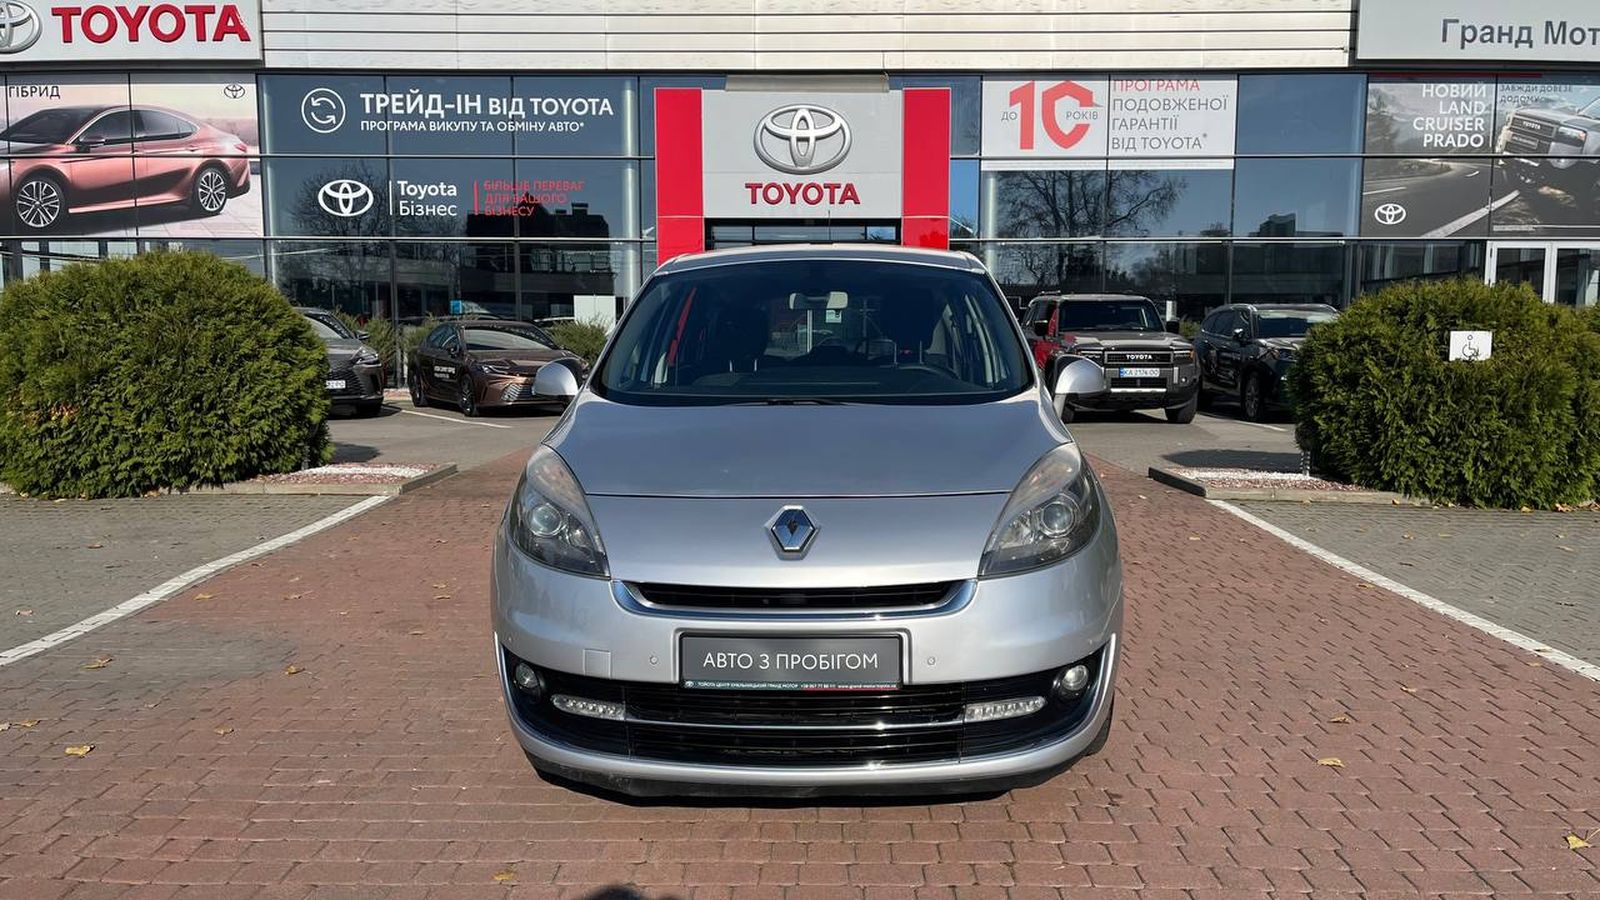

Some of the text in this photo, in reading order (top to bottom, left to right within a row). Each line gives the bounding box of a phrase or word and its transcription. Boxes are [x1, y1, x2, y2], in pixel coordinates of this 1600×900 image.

[51, 4, 251, 43] TOYOTA
[1441, 19, 1533, 50] Гранд
[8, 85, 61, 99] ГІБРИД
[1112, 78, 1200, 92] ПРОГРАМА
[1422, 80, 1487, 98] НОВИЙ
[360, 88, 614, 118] ТРЕЙД-ІН ВІД TOYOTA
[1112, 95, 1229, 112] ПОДОВЖЕНОЇ
[1439, 100, 1486, 115] LAND
[1001, 111, 1018, 121] ДО
[1065, 111, 1099, 120] РОКІВ
[1112, 115, 1178, 131] ГАРАНТІЇ
[1412, 117, 1485, 131] CRUISER
[360, 121, 427, 132] ПРОГРАМА
[429, 121, 478, 132] ВИКУПУ
[480, 121, 494, 132] ТА
[497, 121, 546, 132] ОБМІНУ
[1111, 136, 1137, 152] ВІД
[1423, 133, 1484, 148] PRADO
[397, 180, 457, 200] Toyota
[484, 179, 585, 192] БІЛЬШЕ ПЕРЕВАГ
[745, 182, 861, 205] TOYOTA
[484, 192, 568, 205] ДЛЯ ВАШОГО
[400, 200, 457, 216] Бізнес
[484, 205, 535, 216] БІЗНЕСУ
[703, 652, 878, 670] АВТО З ПРОБІГОМ
